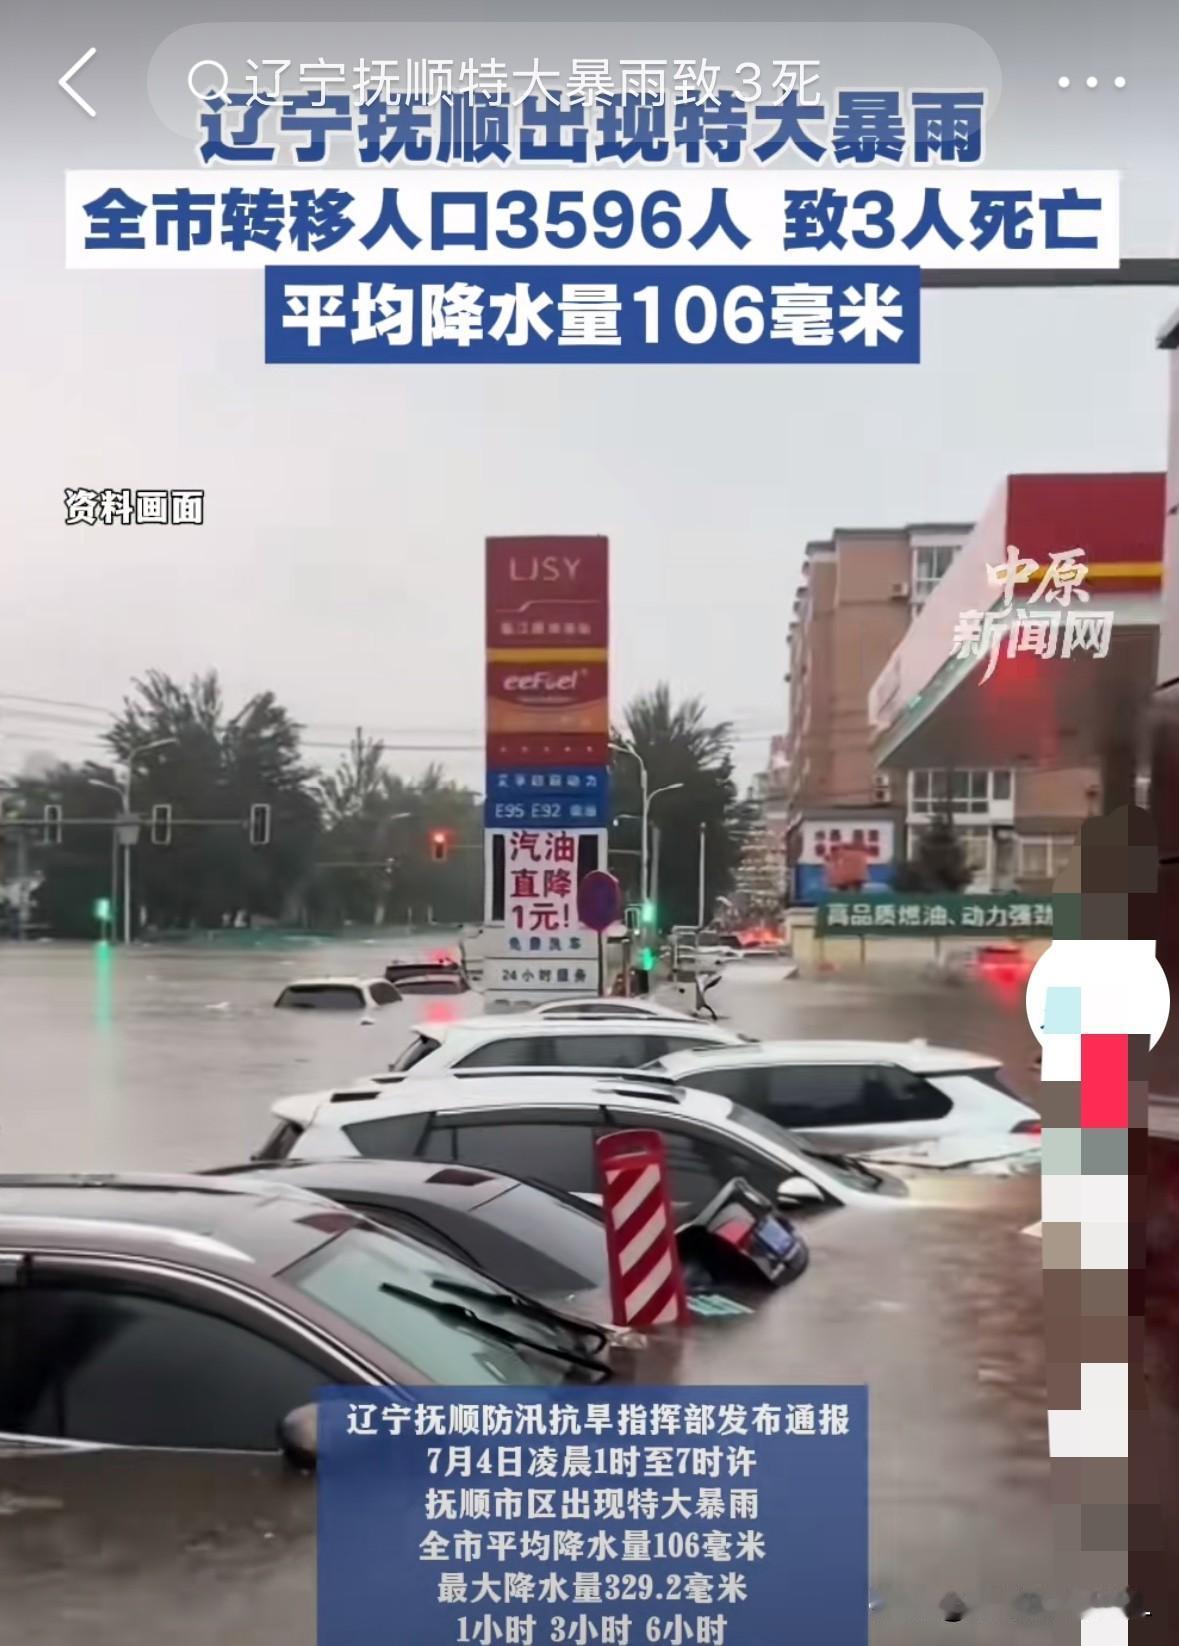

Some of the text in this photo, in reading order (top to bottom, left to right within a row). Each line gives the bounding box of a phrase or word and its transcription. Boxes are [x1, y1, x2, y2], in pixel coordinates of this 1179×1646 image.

[509, 556, 581, 582] LJSY
[495, 803, 525, 818] E95
[531, 803, 561, 818] E92
[510, 831, 575, 863] 汽油
[510, 868, 572, 899] 直降
[511, 902, 570, 932] 1元!
